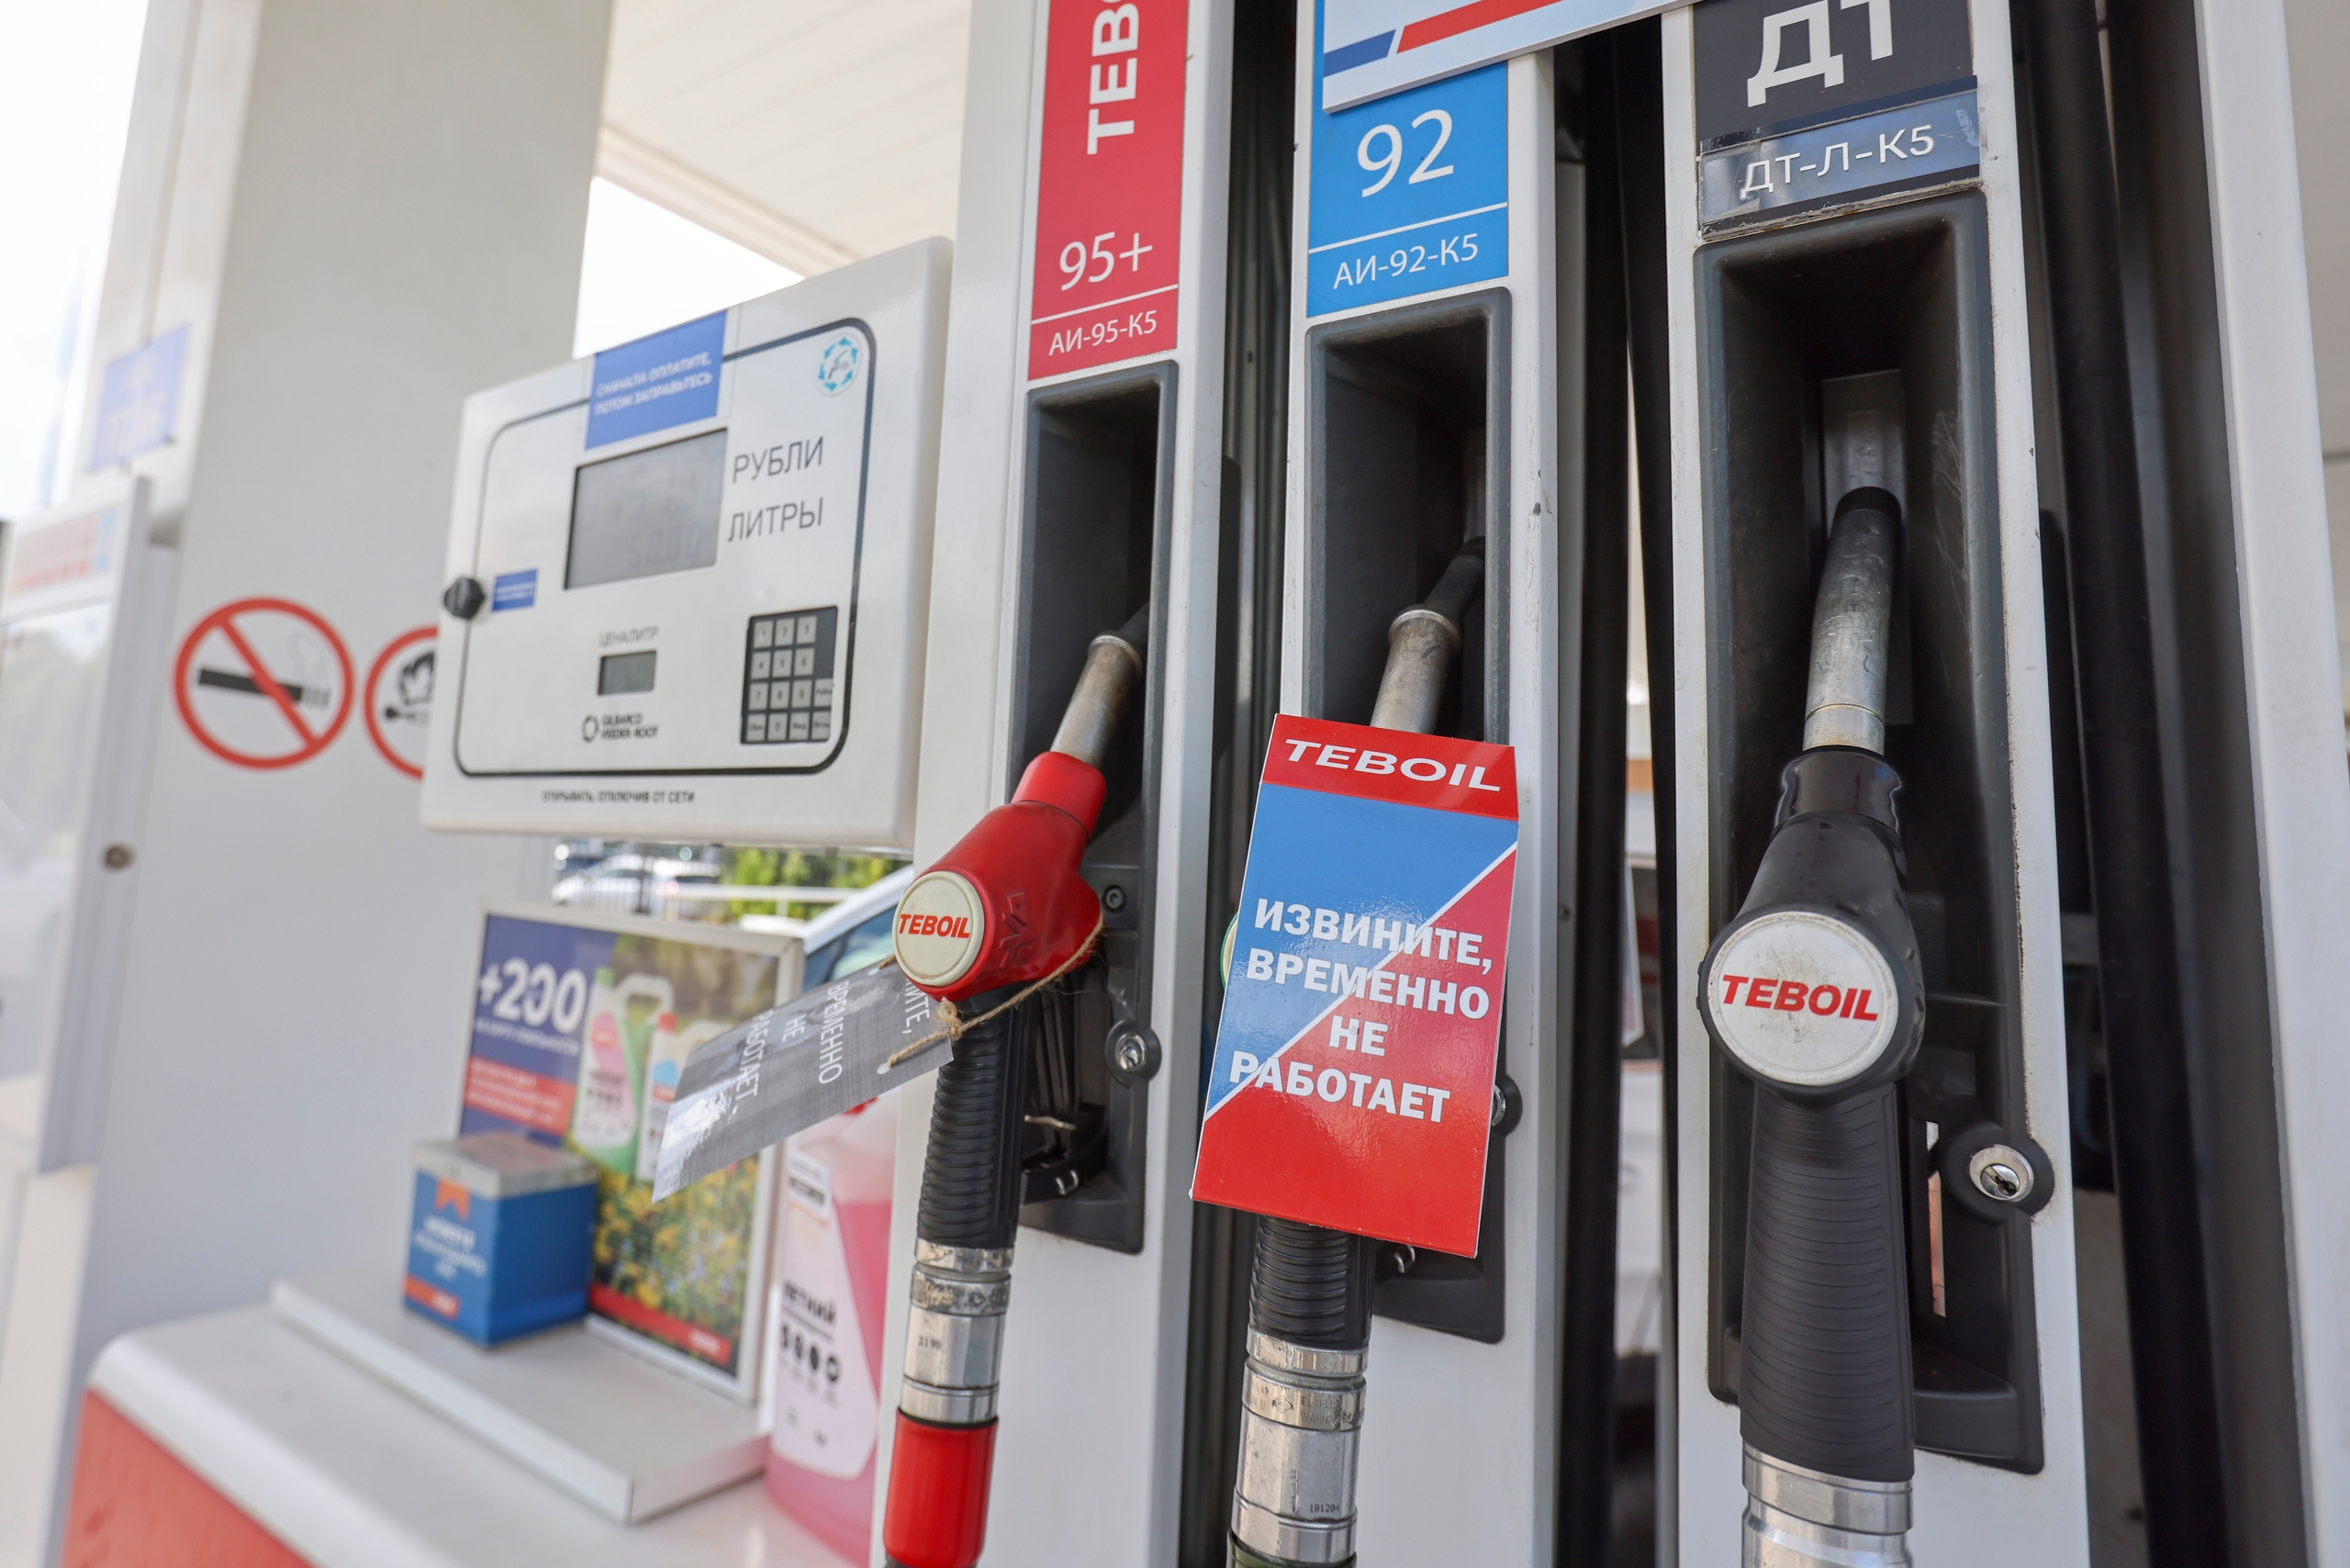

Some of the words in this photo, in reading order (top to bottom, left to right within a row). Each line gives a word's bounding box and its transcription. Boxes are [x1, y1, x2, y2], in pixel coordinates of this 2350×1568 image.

[1087, 0, 1139, 155] TEB
[1747, 0, 1893, 107] ДТ
[1357, 108, 1454, 198] 92
[1740, 124, 1934, 199] ДТ-Л-К5
[1058, 230, 1154, 291] 95+
[1333, 232, 1479, 290] АИ-92-К5
[1048, 309, 1158, 356] АИ-95-К5
[733, 436, 823, 484] РУБЛИ
[727, 497, 823, 542] ЛИТРЫ
[1286, 738, 1501, 792] TEBOIL
[899, 913, 970, 939] TEBOIL
[1254, 898, 1493, 976] ИЗВИНИТЕ,
[1246, 948, 1491, 1020] ВРЕМЕННО
[1722, 974, 1879, 1022] TEBOIL
[782, 1014, 807, 1043] НЕ
[818, 980, 849, 1084] ВРЕМЕННО
[1329, 1015, 1388, 1057] НЕ
[1229, 1050, 1450, 1123] РАБОТАЕТ
